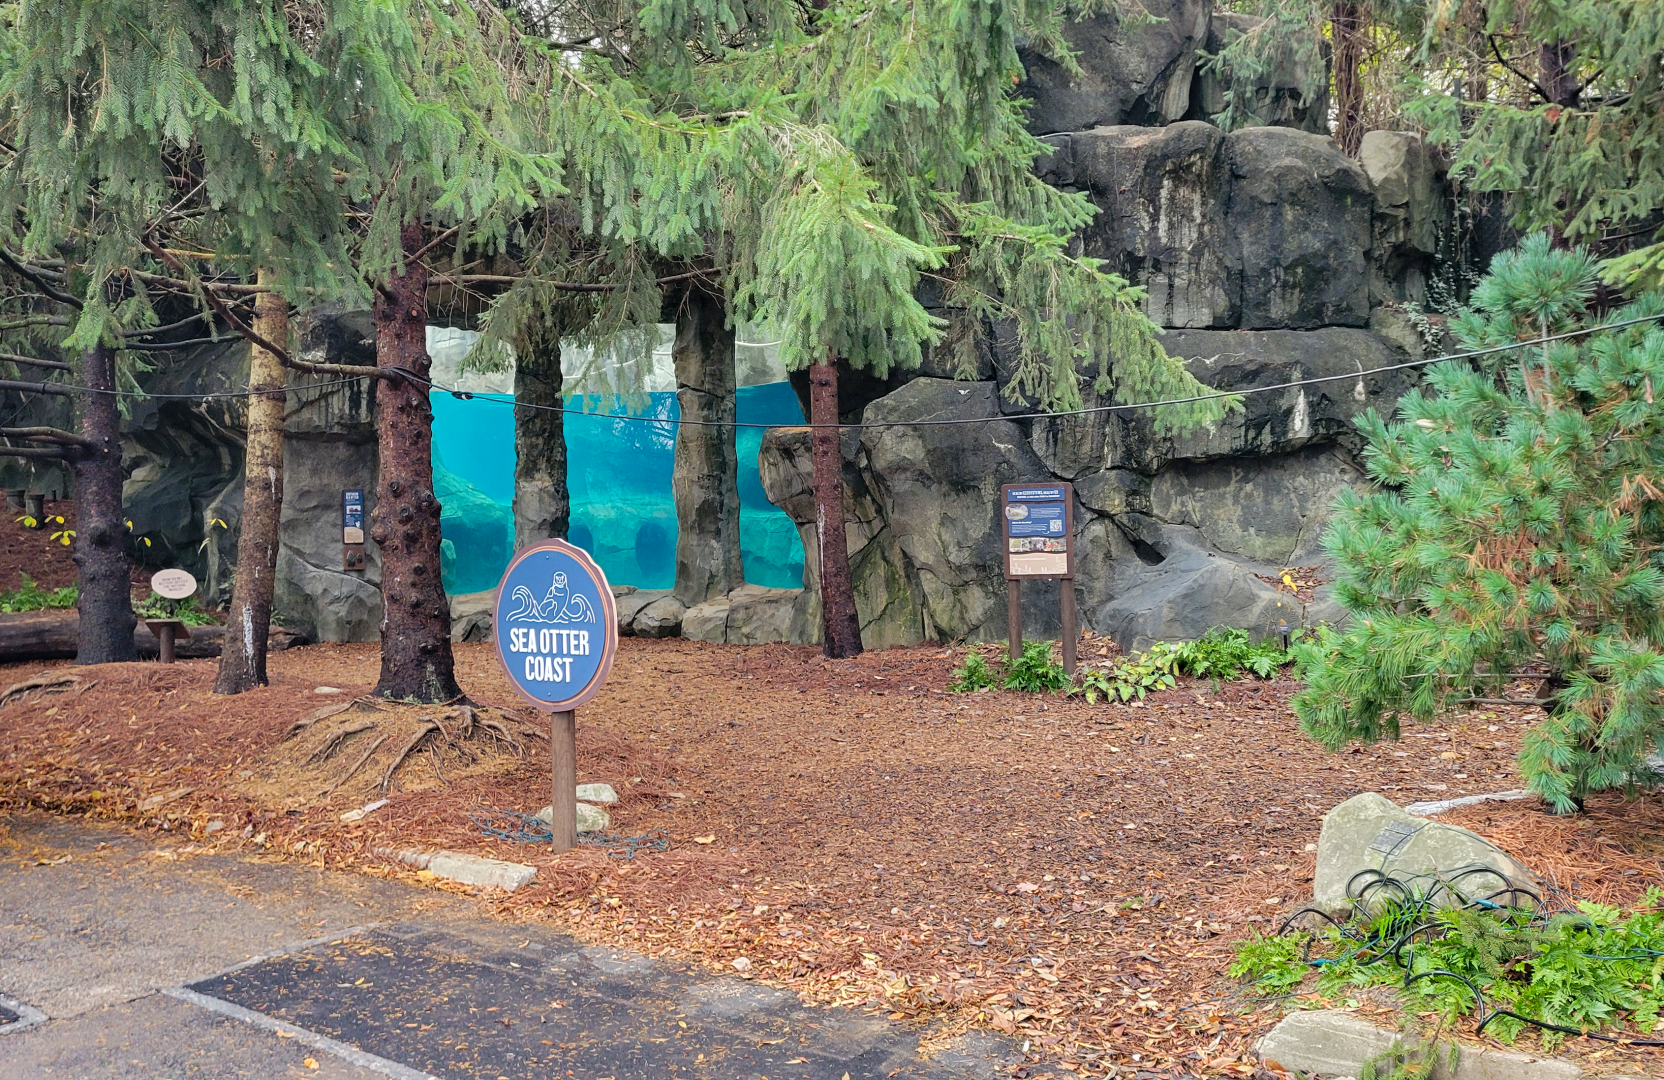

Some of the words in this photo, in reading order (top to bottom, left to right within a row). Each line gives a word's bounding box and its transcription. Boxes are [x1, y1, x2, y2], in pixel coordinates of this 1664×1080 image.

[510, 628, 537, 653] SEA
[540, 629, 589, 656] OTTER
[525, 656, 573, 683] COAST
